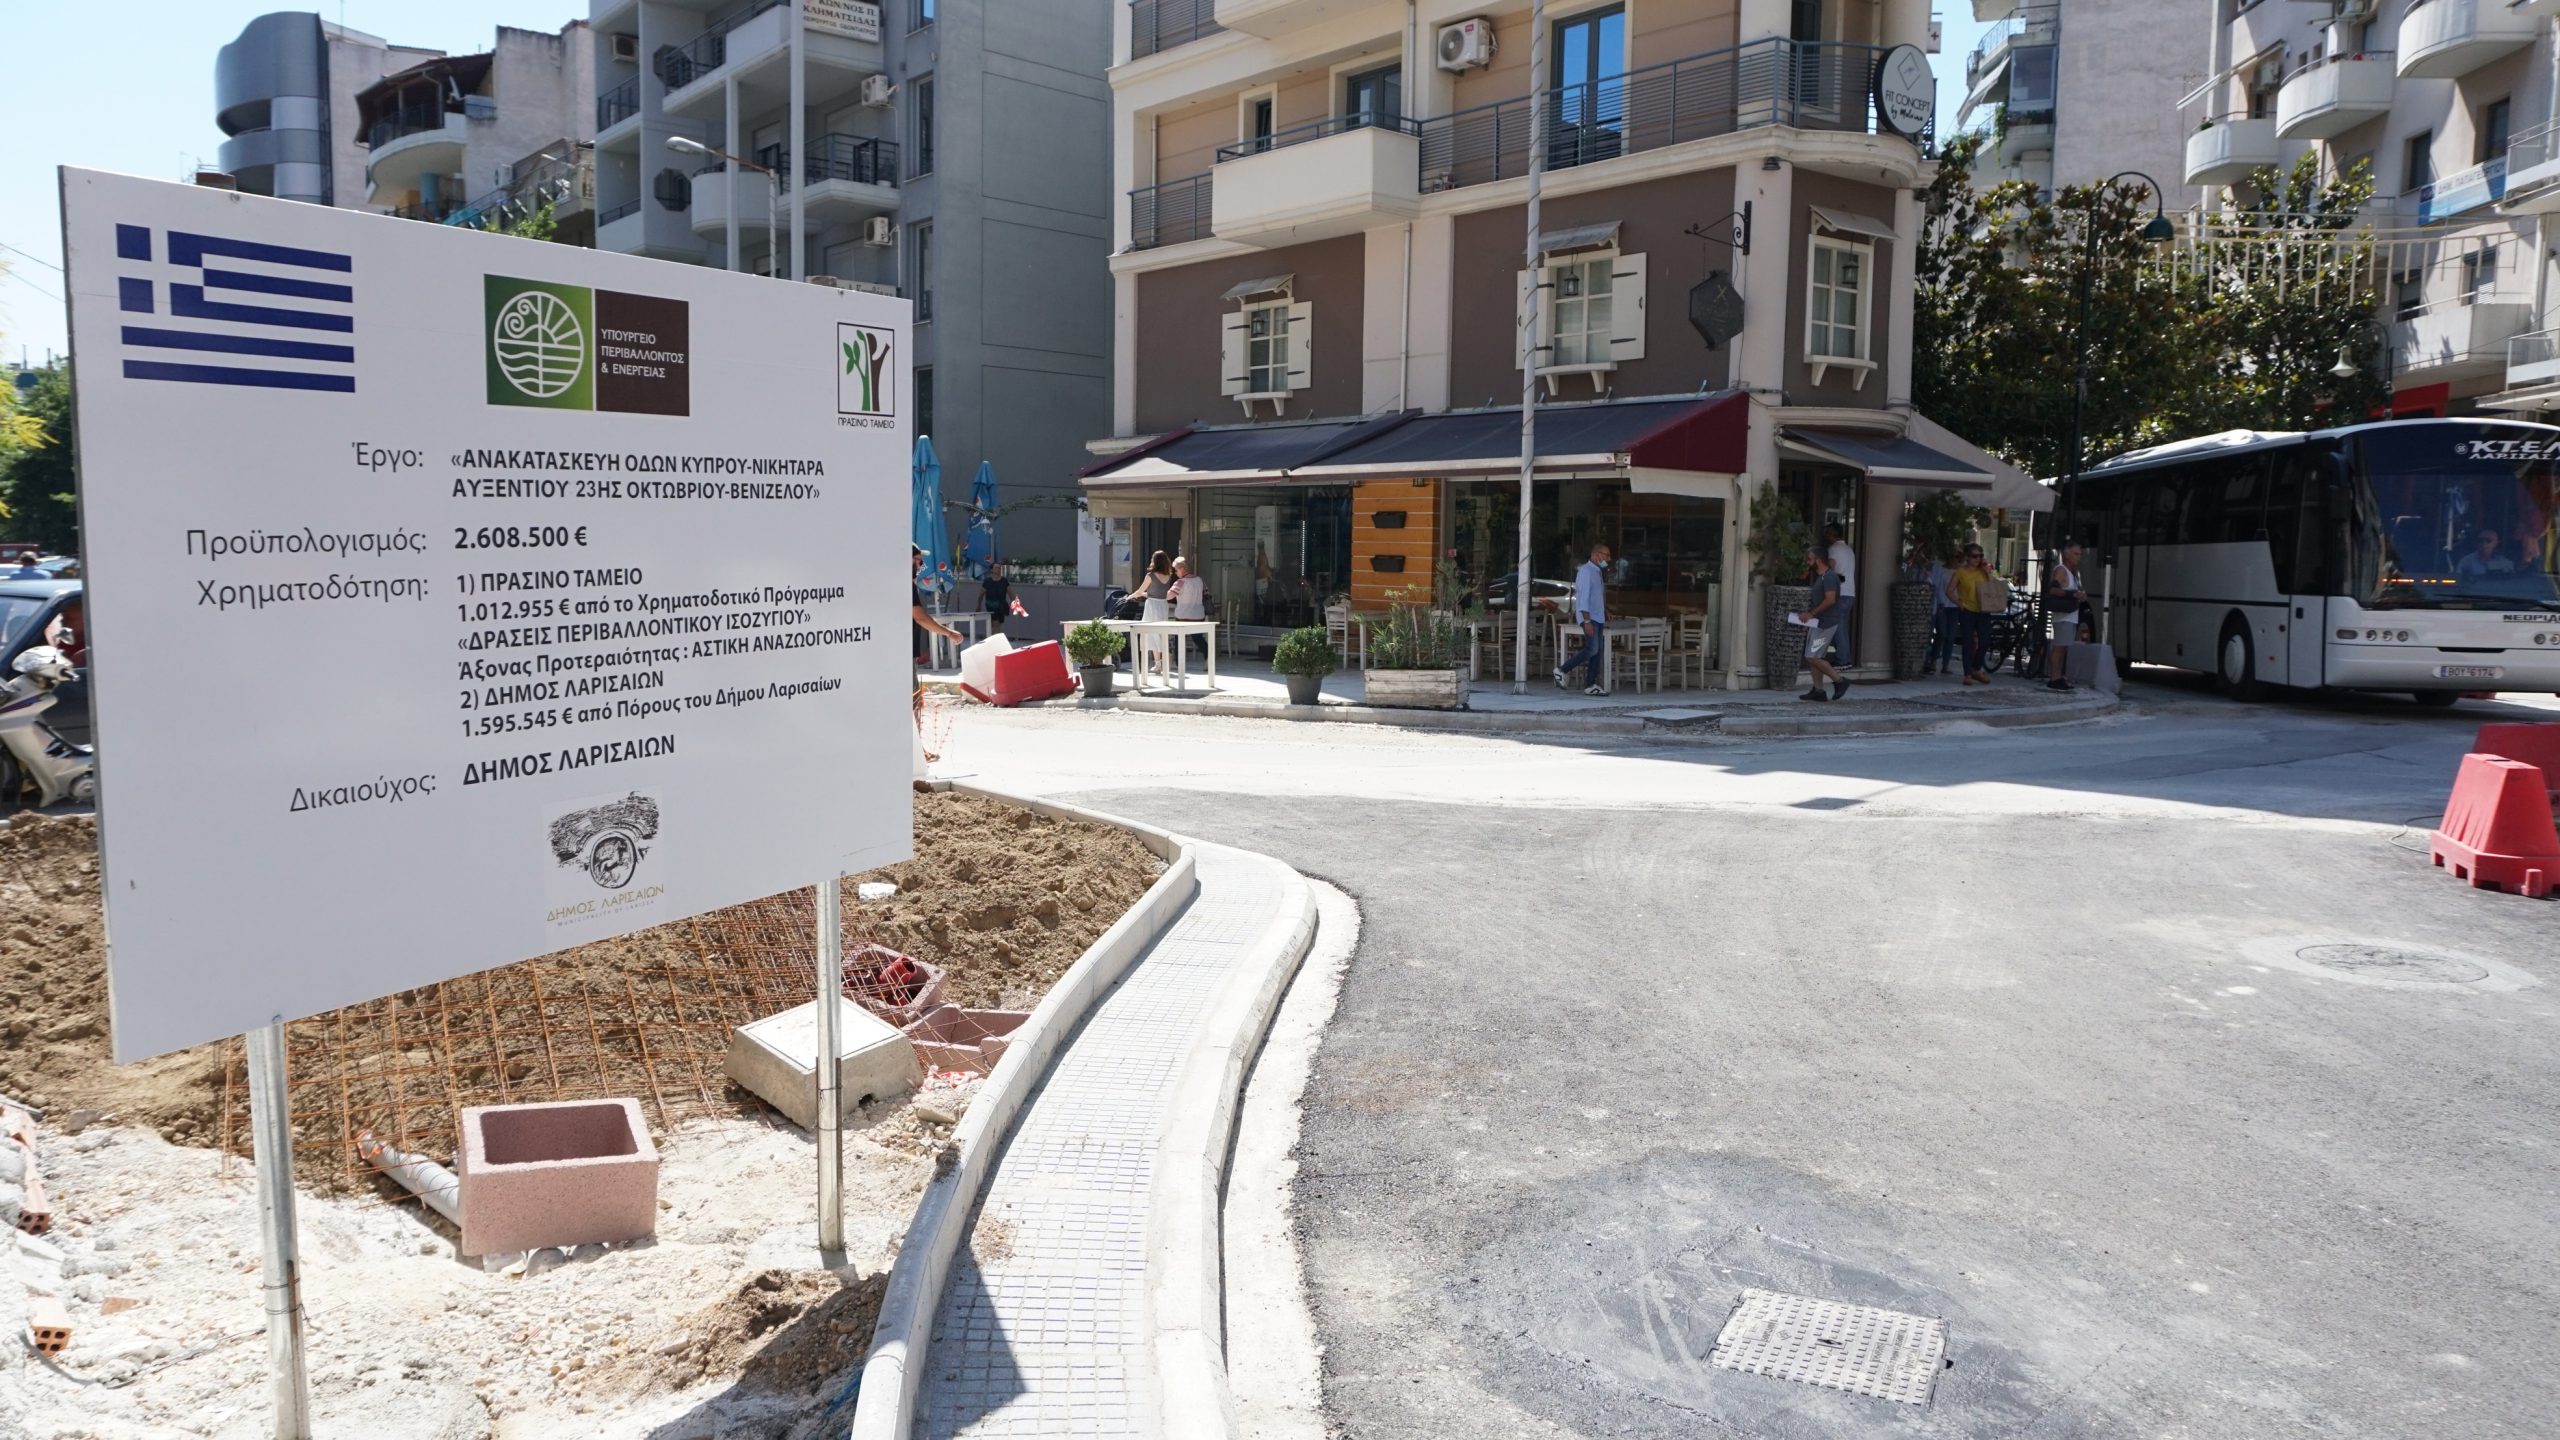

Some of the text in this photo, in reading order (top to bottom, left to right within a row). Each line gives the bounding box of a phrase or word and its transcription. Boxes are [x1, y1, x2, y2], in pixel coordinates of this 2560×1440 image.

[1896, 93, 1931, 113] CONCEPT
[601, 329, 656, 344] ΥΠΟΥΡΓΕΙΟ
[601, 346, 684, 363] ΠΕΡΙΒΑΛΛΟΝΤΟΣ
[601, 362, 665, 378] & ΕΝΕΡΓΕΙΑΣ
[838, 417, 894, 429] ΠΡΑΣΙΝΟ ΤΑΜΕΙΟ
[352, 442, 423, 472] Έργο:
[452, 449, 824, 476] «ΑΝΑΚΑΤΑΣΚΕΥΗ ΟΔΩΝ ΚΥΠΡΟΥ-ΝΙΚΗΤΑΡΑ
[453, 479, 819, 499] ΑΥΞΕΝΤΙΟΥ 23ΗΣ ΟΚΤΩΒΡΙΟΥ-ΒΕΝΙΖΕΛΟΥ»
[187, 527, 426, 561] Προϋπολογισμός:
[455, 526, 587, 549] 2.608.500 €
[197, 574, 428, 611] Χρηματοδότηση:
[457, 568, 642, 595] 1) ΠΡΑΣΙΝΟ ΤΑΜΕΙΟ
[458, 586, 844, 622] 1.012.955 € από το Χρηματοδοτικό Πρόγραμμα
[458, 609, 810, 650] «ΔΡΑΣΕΙΣ ΠΕΡΙΒΑΛΛΟΝΤΙΚΟΥ ΙΣΟΖΥΓΙΟΥ»
[459, 626, 870, 681] Άξονας Προτεραιότητας : ΑΣΤΙΚΗ ΑΝΑΖΩΟΓΟΝΗΣΗ
[461, 671, 663, 710] 2) ΔΗΜΟΣ ΛΑΡΙΣΑΙΩΝ
[463, 677, 841, 737] 1.595.545 € από Πόρους του Δήμου Λαρισαίων
[463, 735, 674, 785] ΔΗΜΟΣ ΛΑΡΙΣΑΙΩΝ
[290, 775, 435, 812] Δικαιούχος:
[547, 884, 664, 921] ΔΗΜΟΣ ΛΑΡΙΣΑΙΩΝ
